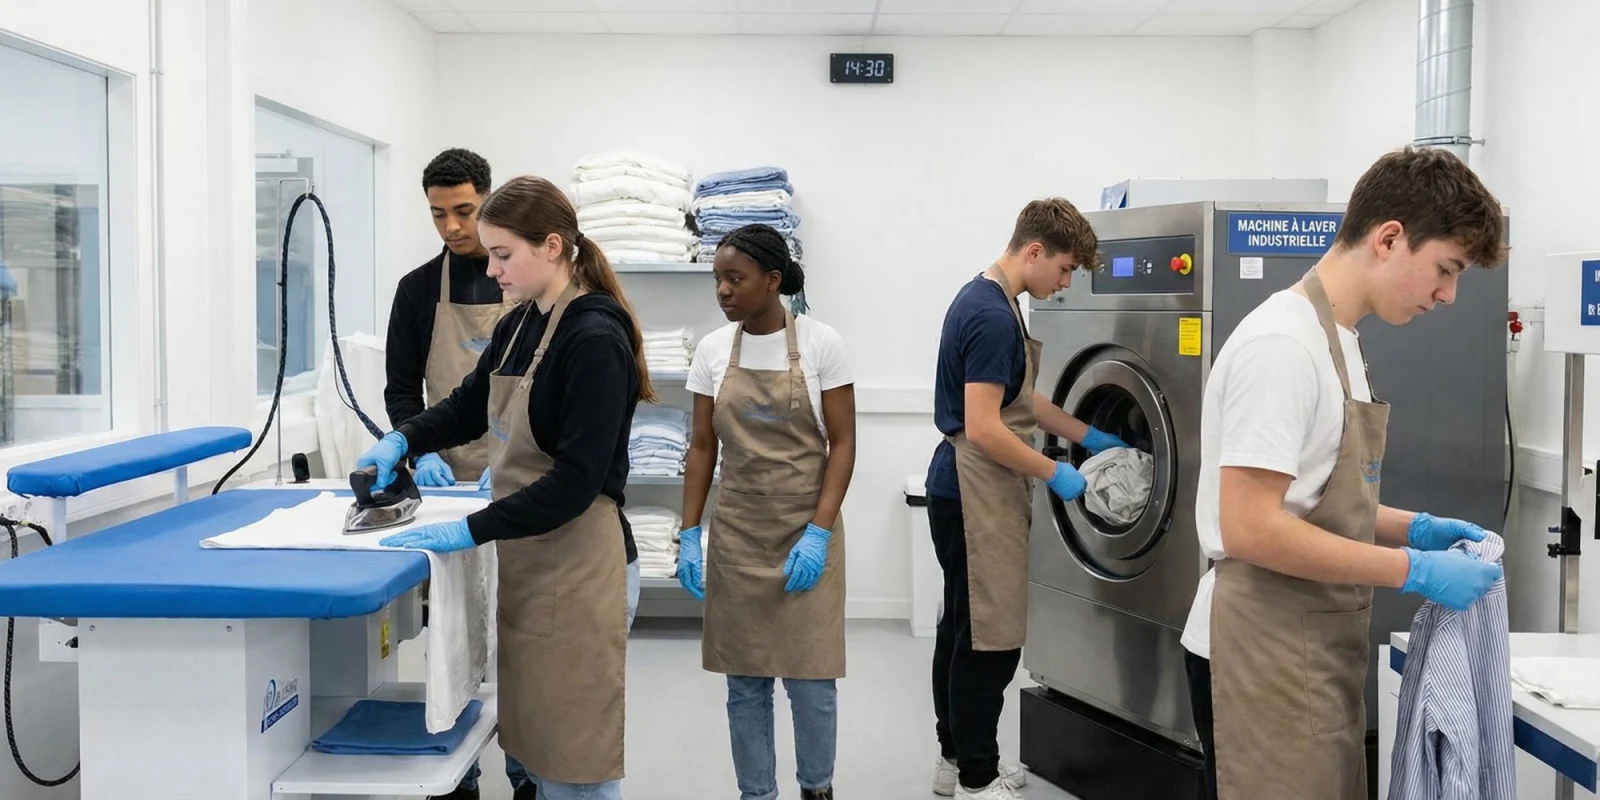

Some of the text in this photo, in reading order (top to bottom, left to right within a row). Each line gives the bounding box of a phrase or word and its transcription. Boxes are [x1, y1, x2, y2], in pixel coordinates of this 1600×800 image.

[845, 60, 885, 76] 14:30
[1238, 217, 1337, 233] MACHINE À LAVER
[1248, 234, 1326, 247] INDUSTRIELLE
